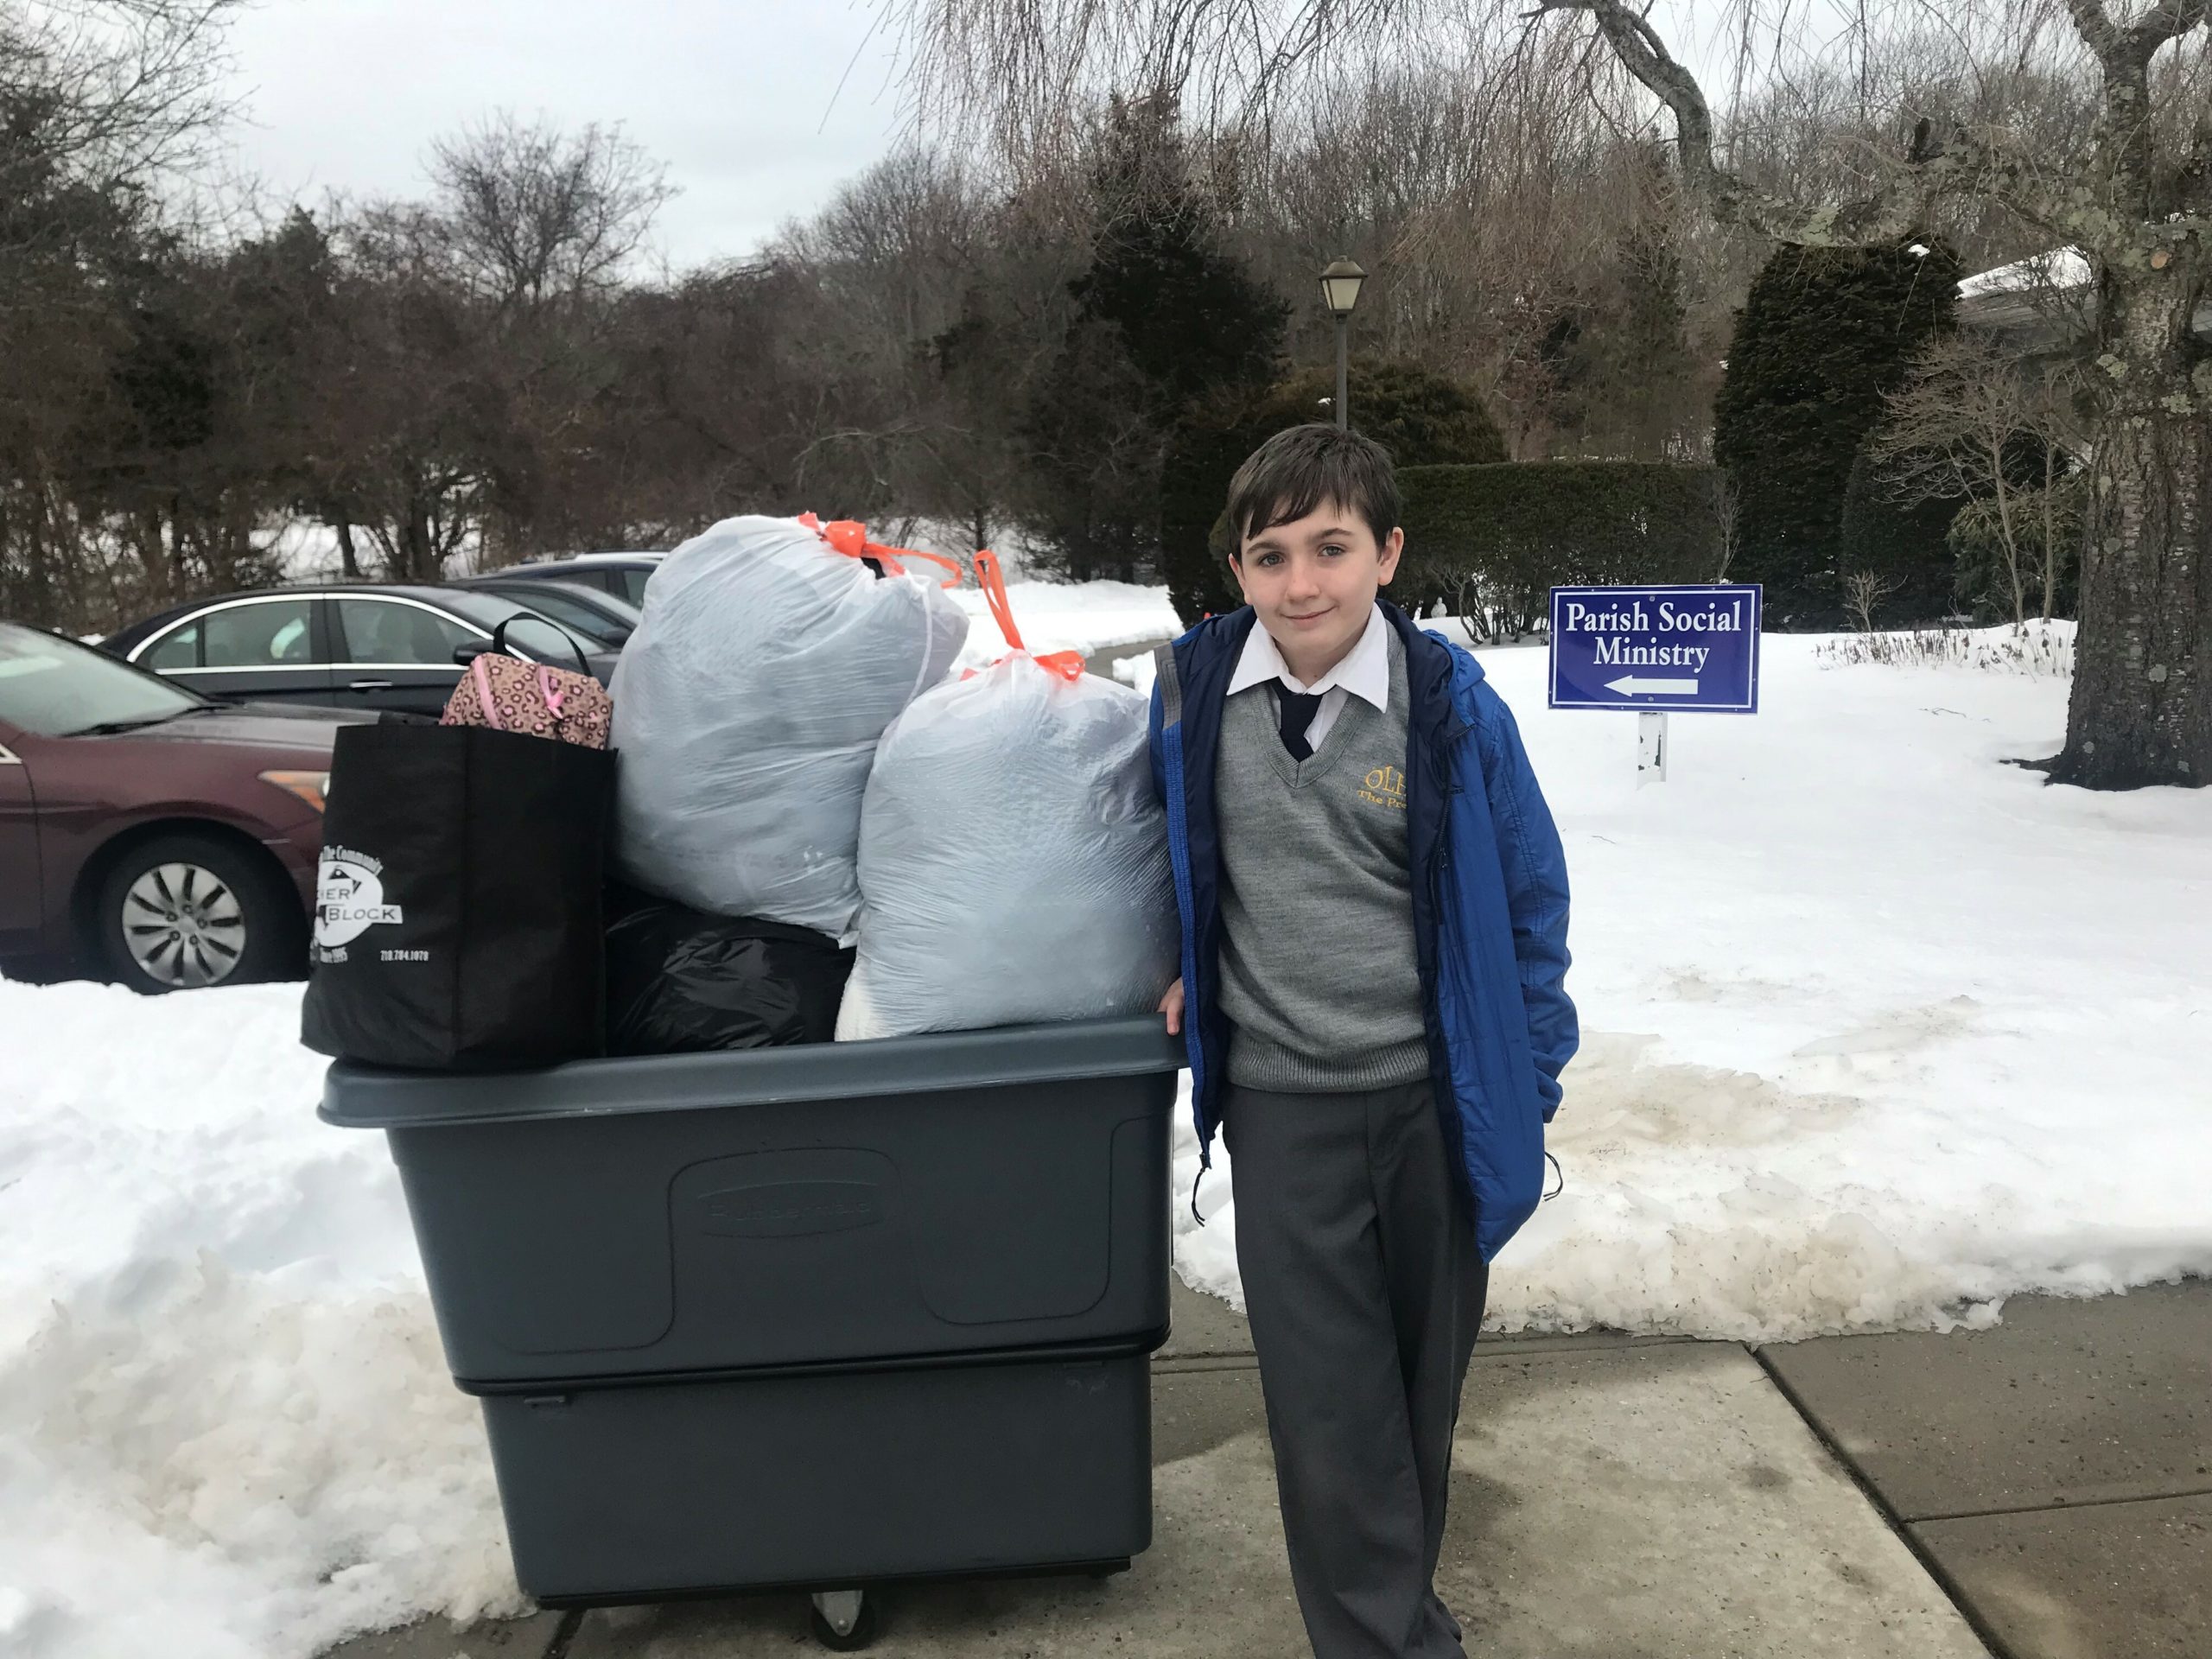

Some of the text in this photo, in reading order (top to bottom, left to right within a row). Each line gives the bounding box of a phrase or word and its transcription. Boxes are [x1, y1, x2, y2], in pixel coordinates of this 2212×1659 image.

[1566, 601, 1742, 632] Parish Social
[1593, 636, 1710, 674] Ministry
[1357, 790, 1383, 804] The
[328, 907, 396, 921] BLOCK
